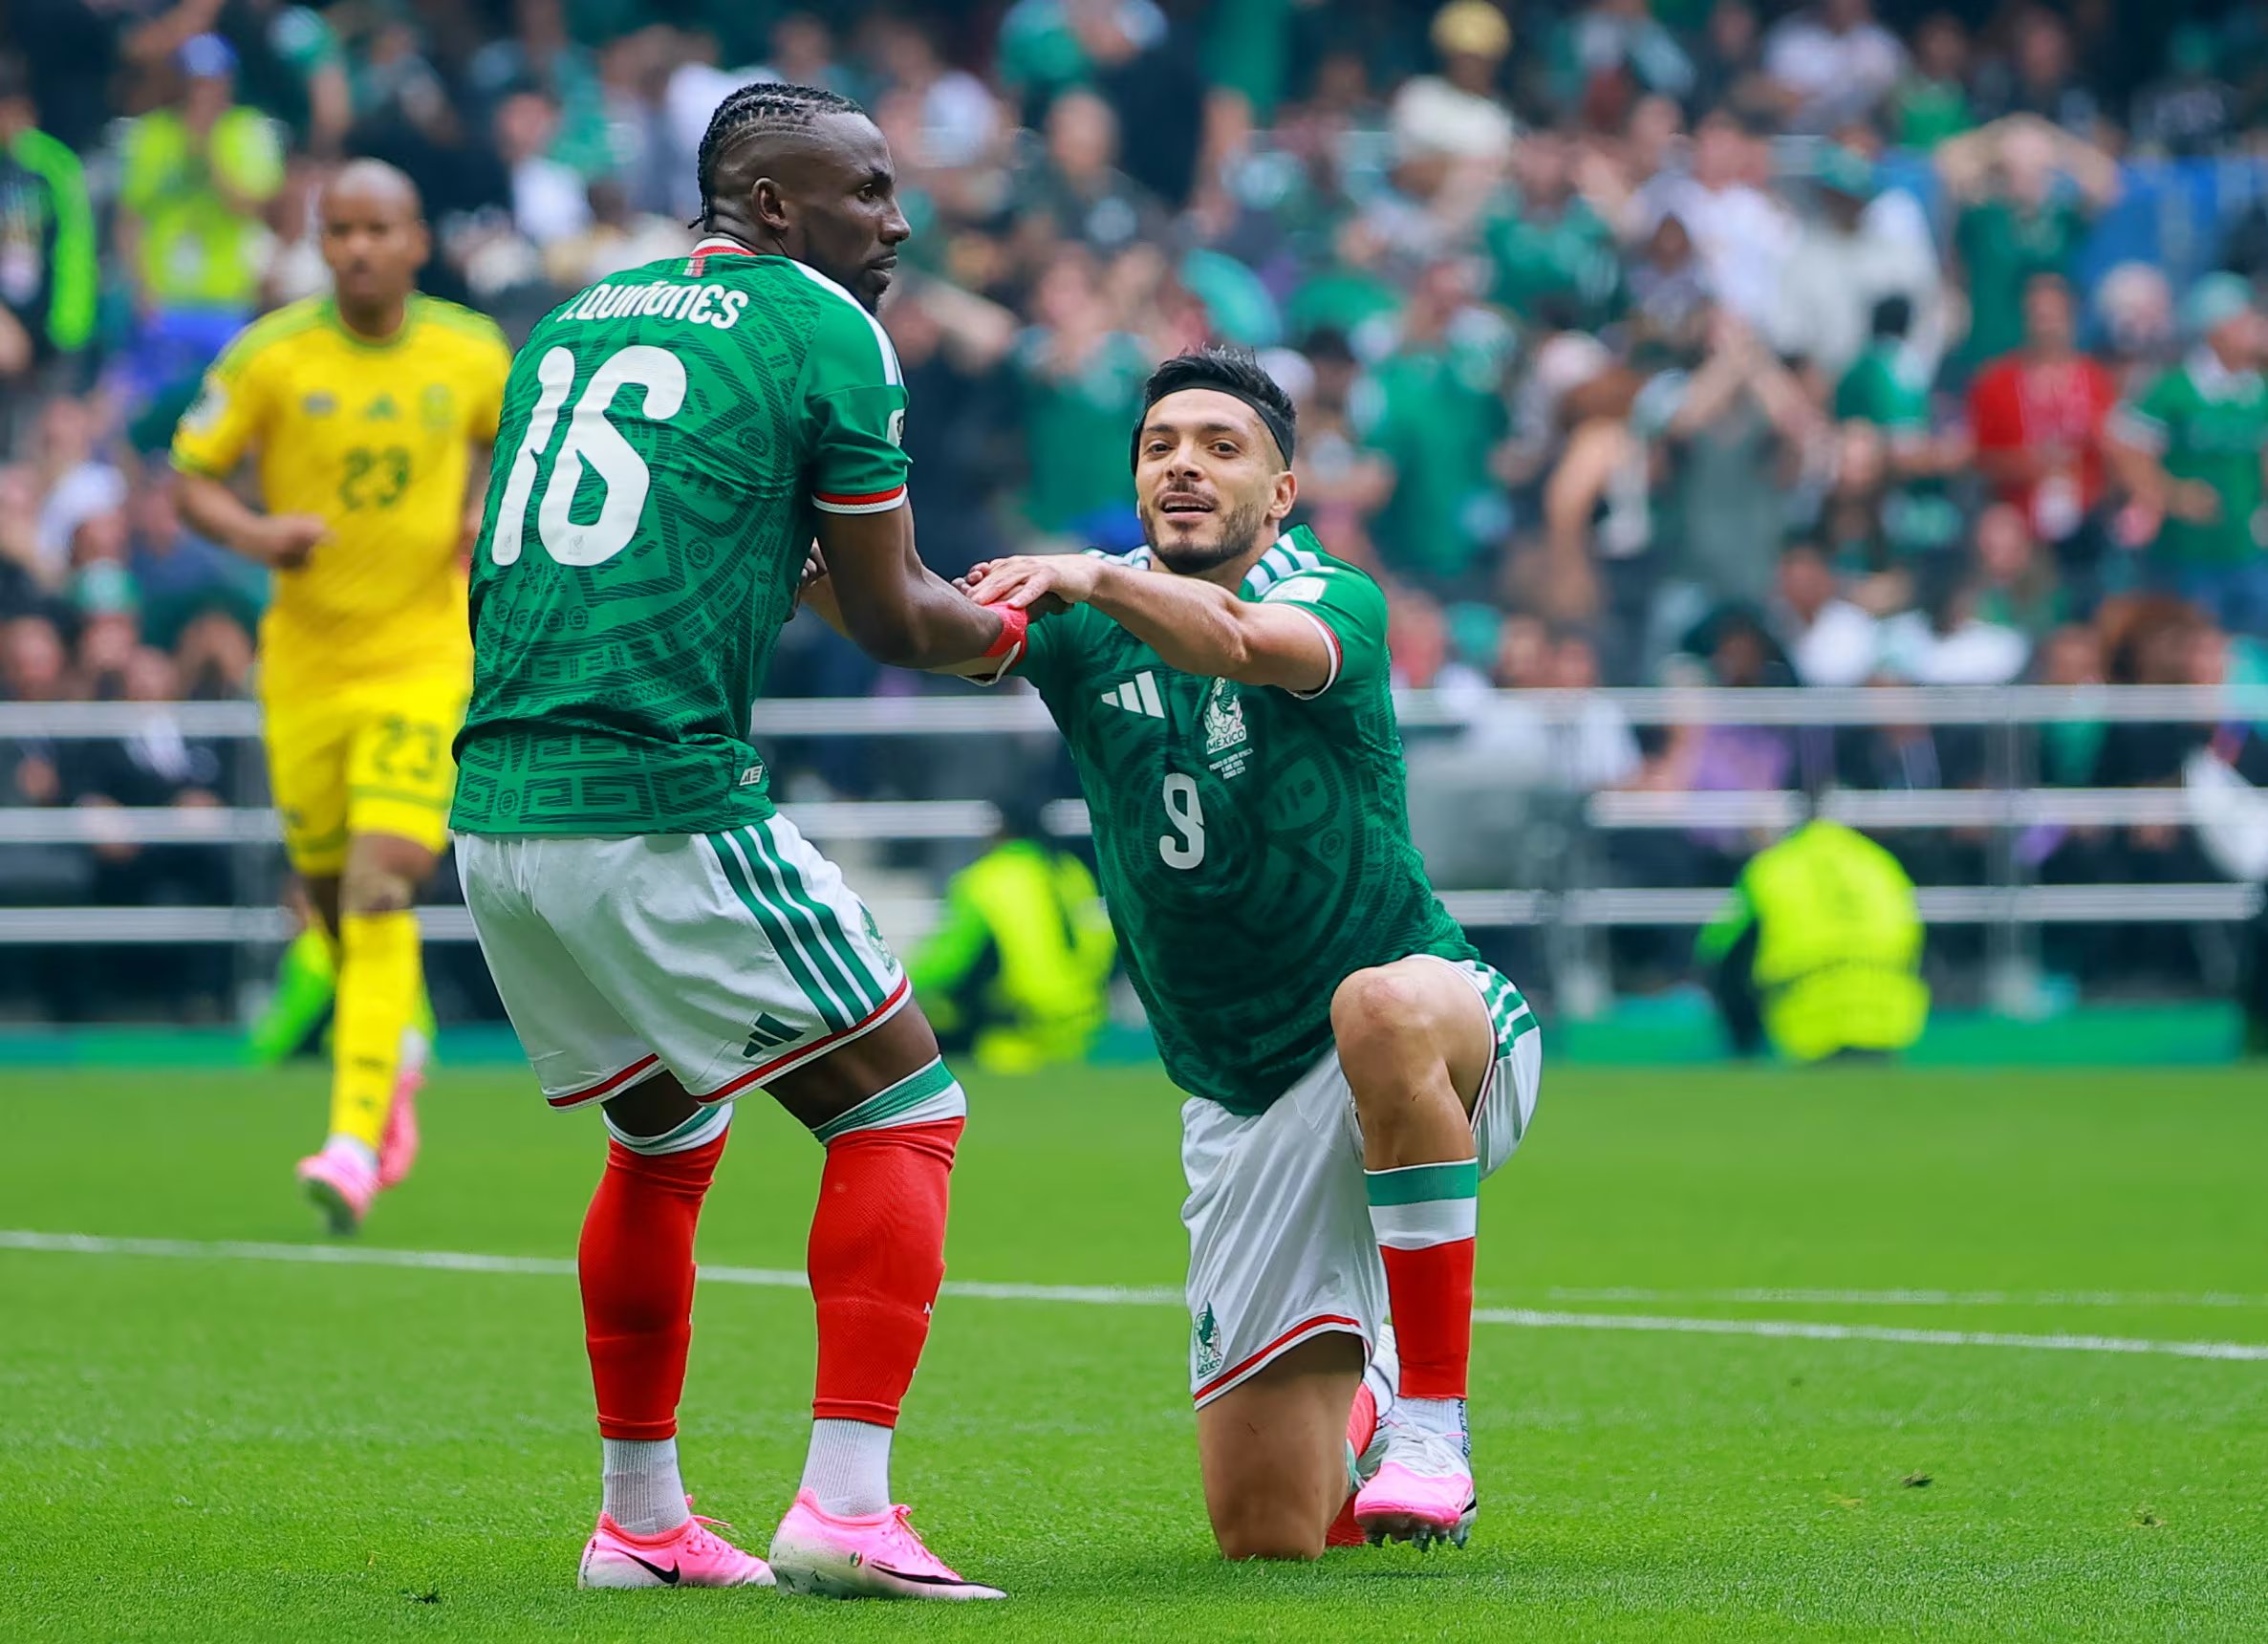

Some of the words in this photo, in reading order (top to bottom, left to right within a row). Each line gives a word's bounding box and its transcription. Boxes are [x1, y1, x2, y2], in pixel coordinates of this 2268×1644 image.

[338, 448, 410, 510] 23
[491, 345, 687, 567] 16
[1159, 772, 1204, 870] 9
